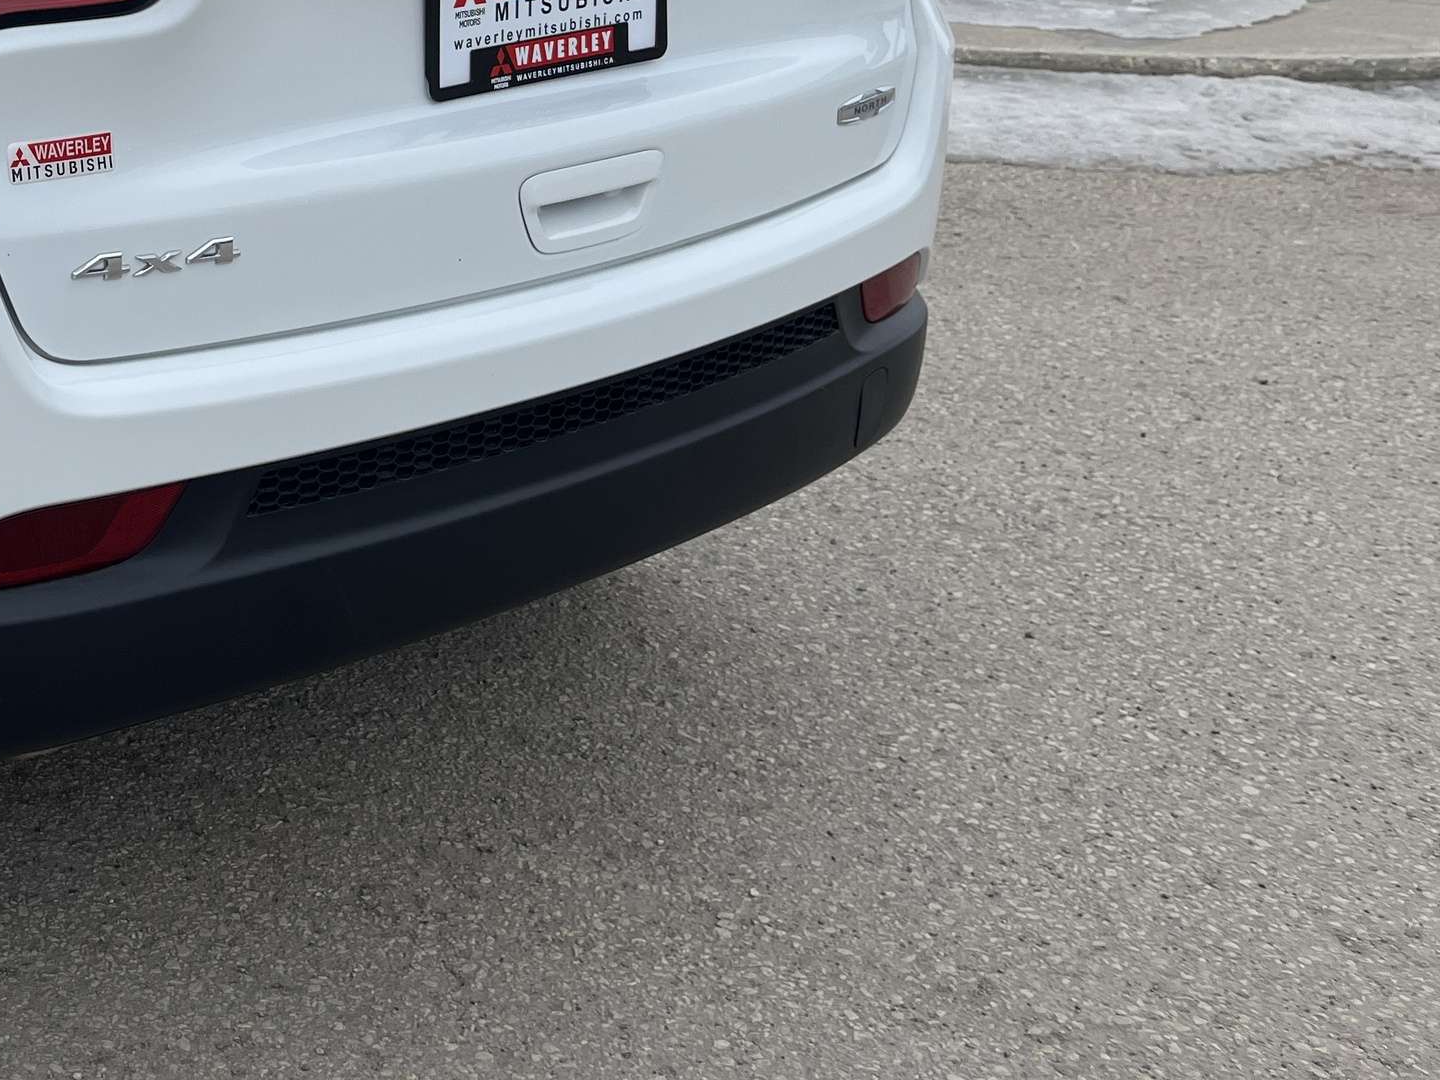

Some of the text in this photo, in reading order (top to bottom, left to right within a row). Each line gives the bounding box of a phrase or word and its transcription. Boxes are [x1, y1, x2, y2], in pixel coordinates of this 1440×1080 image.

[454, 10, 642, 50] waverleymitsubishi.com
[515, 30, 614, 67] WAVERLEY
[516, 57, 614, 82] WAVERLEYMITSUBISHI.CA
[34, 135, 110, 161] WAVERLEY
[11, 155, 113, 183] MITSUBISHI
